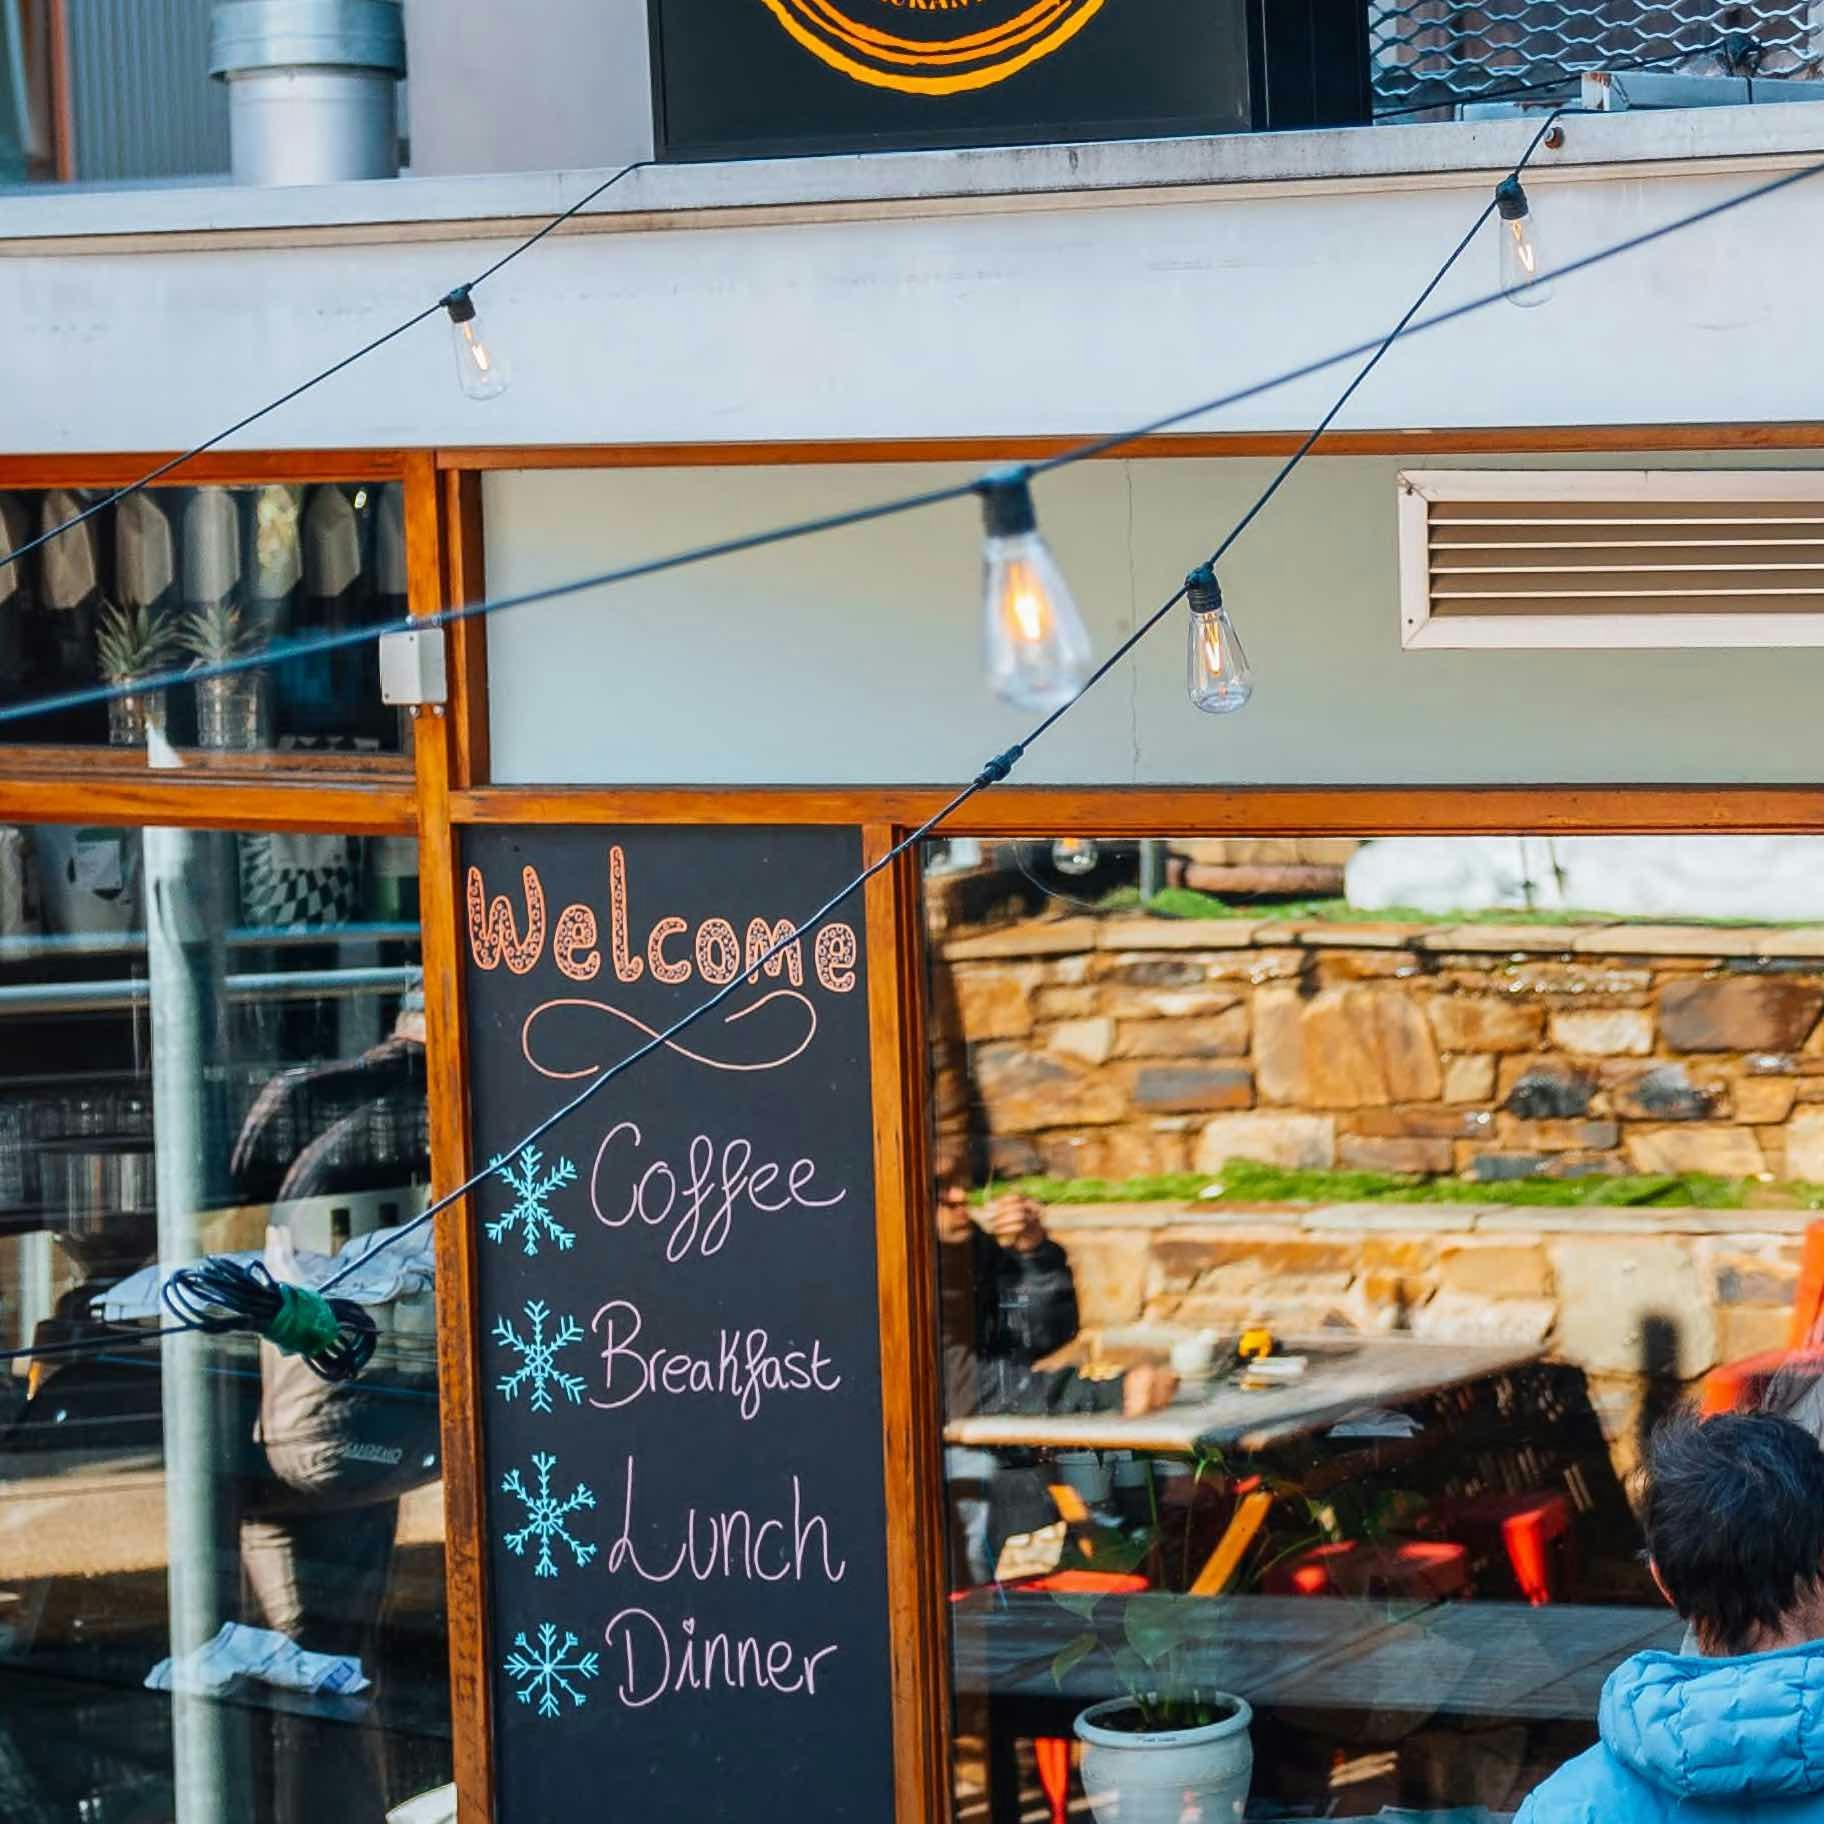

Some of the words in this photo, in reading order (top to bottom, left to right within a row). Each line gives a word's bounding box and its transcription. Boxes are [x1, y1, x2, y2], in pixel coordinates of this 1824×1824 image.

[467, 845, 857, 992] Welcome
[590, 1121, 848, 1263] Coffee
[588, 1299, 842, 1421] Breakfast
[608, 1454, 847, 1583] Lunch
[604, 1607, 839, 1708] Dinner
